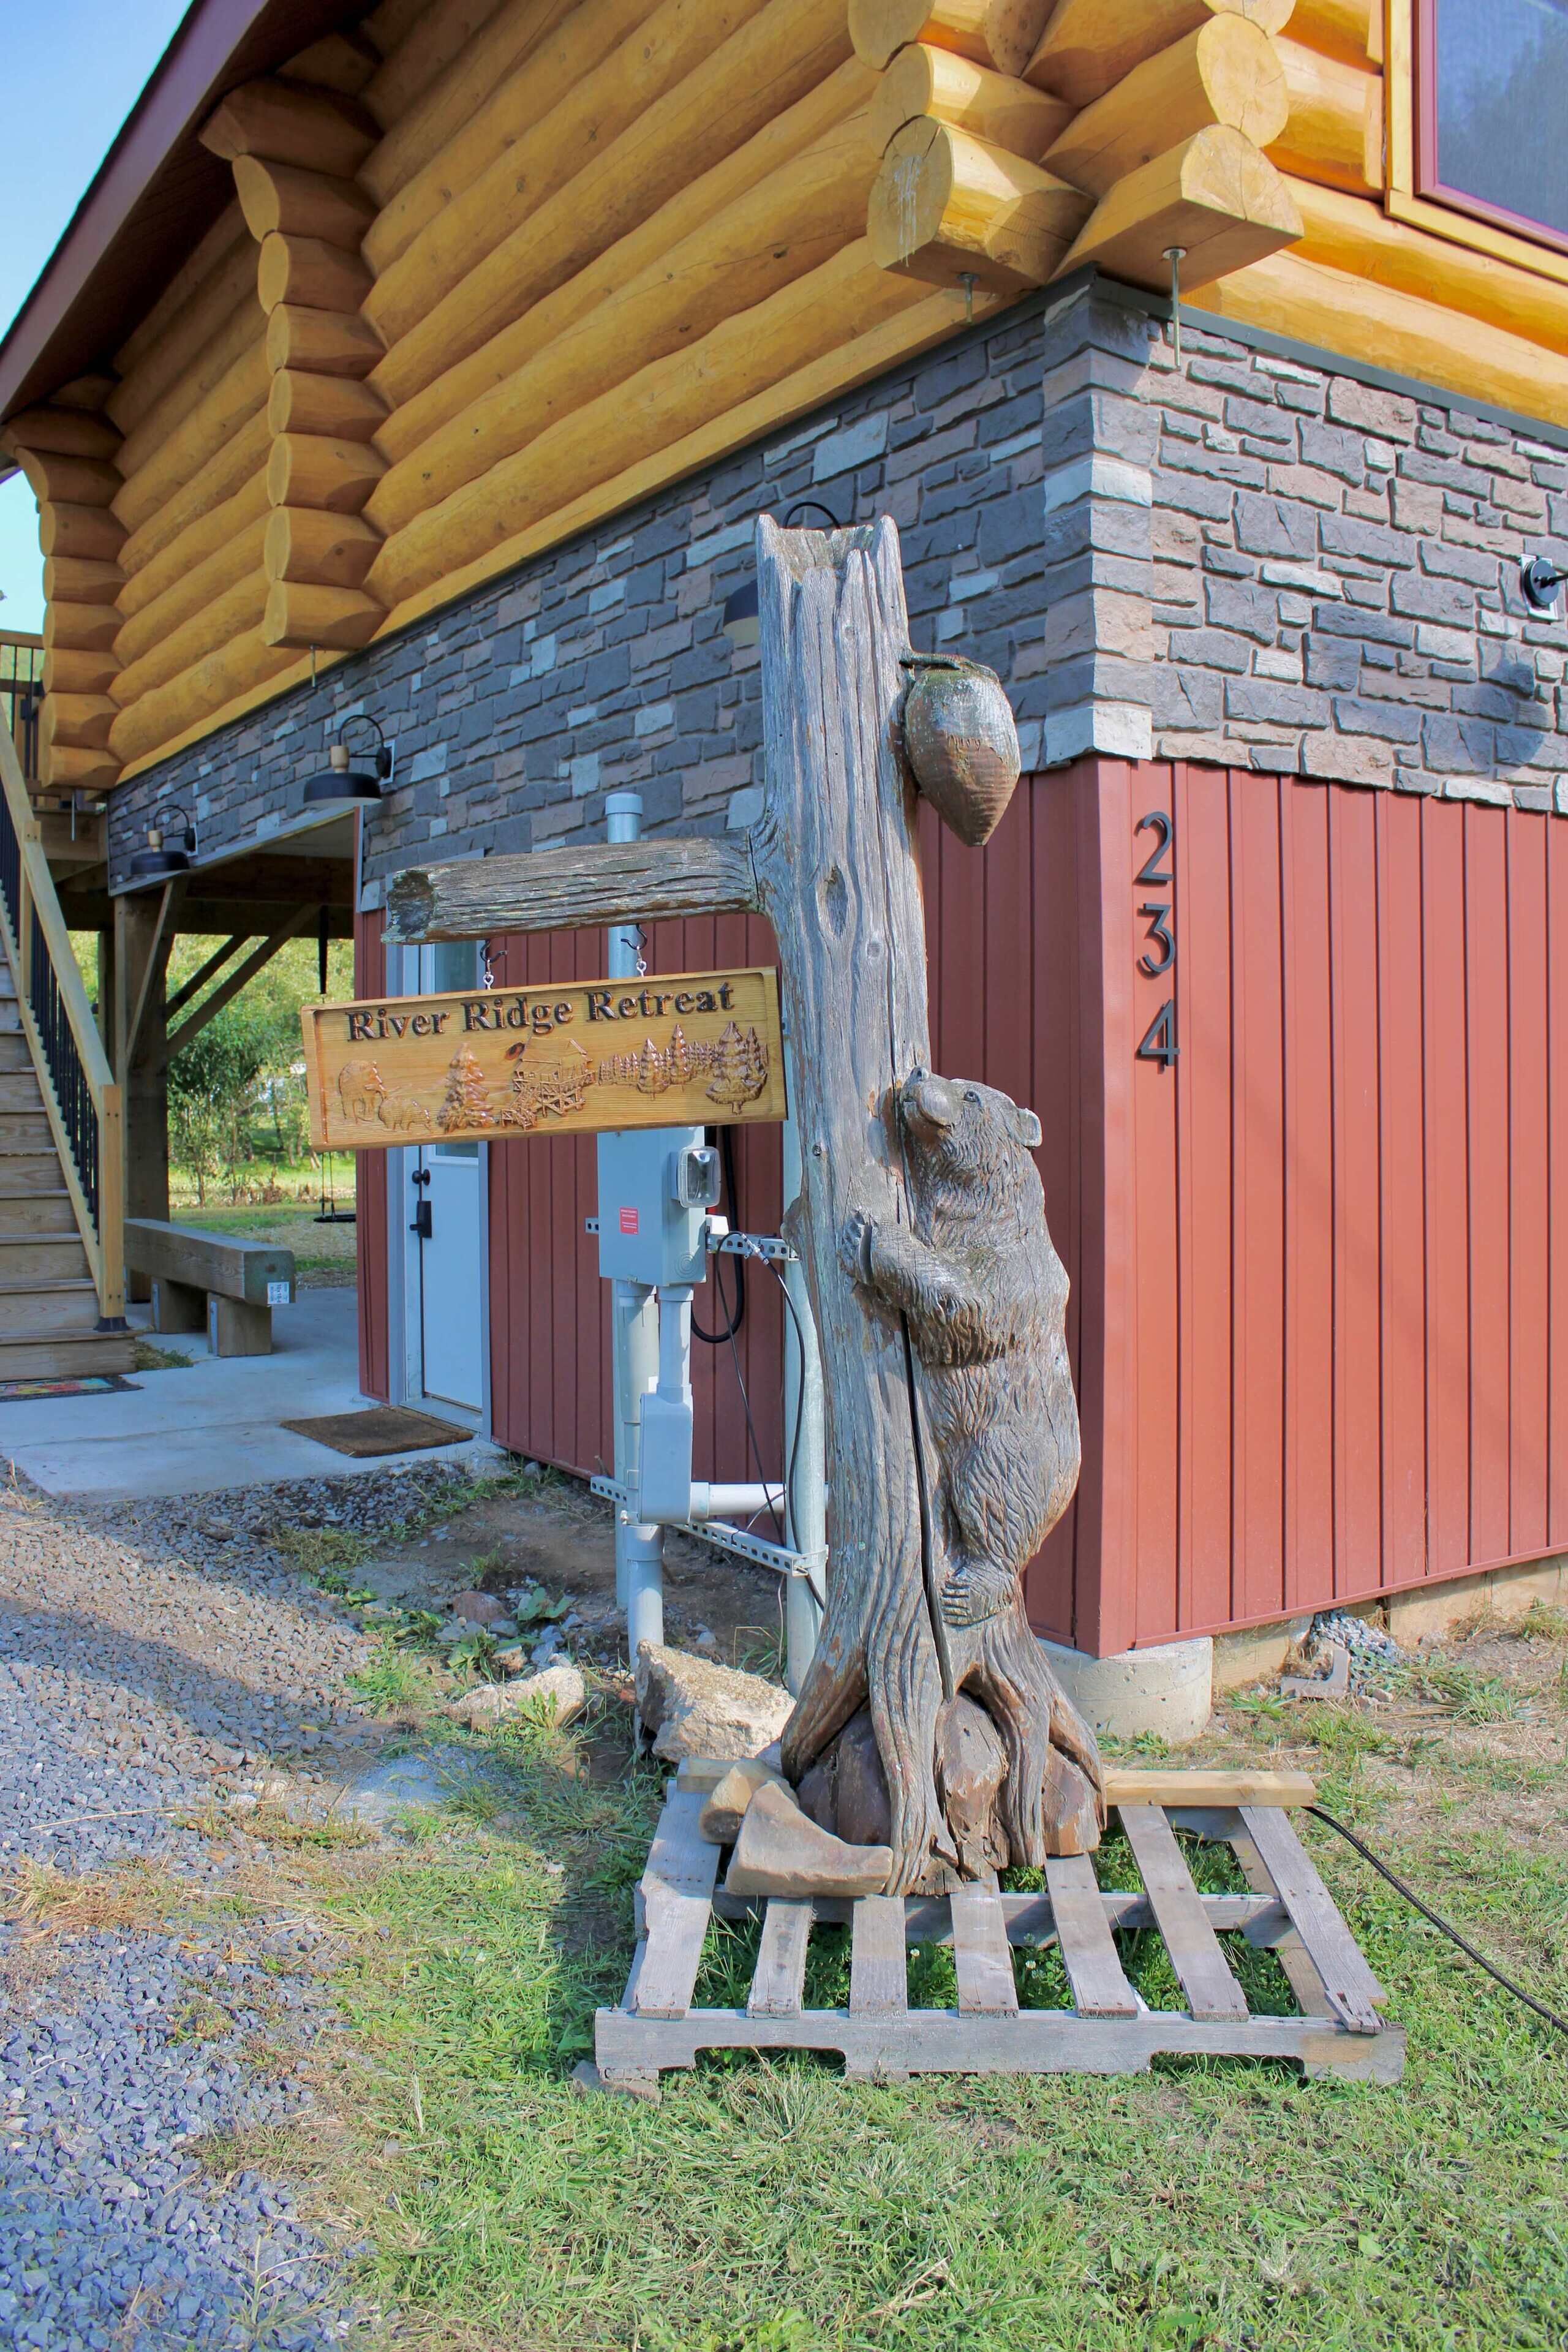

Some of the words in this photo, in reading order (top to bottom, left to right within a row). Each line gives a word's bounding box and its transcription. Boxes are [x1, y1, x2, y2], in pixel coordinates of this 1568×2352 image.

[347, 1009, 451, 1041] River
[461, 997, 573, 1035] Ridge
[584, 981, 734, 1022] Retreat
[1135, 811, 1180, 1067] 234
